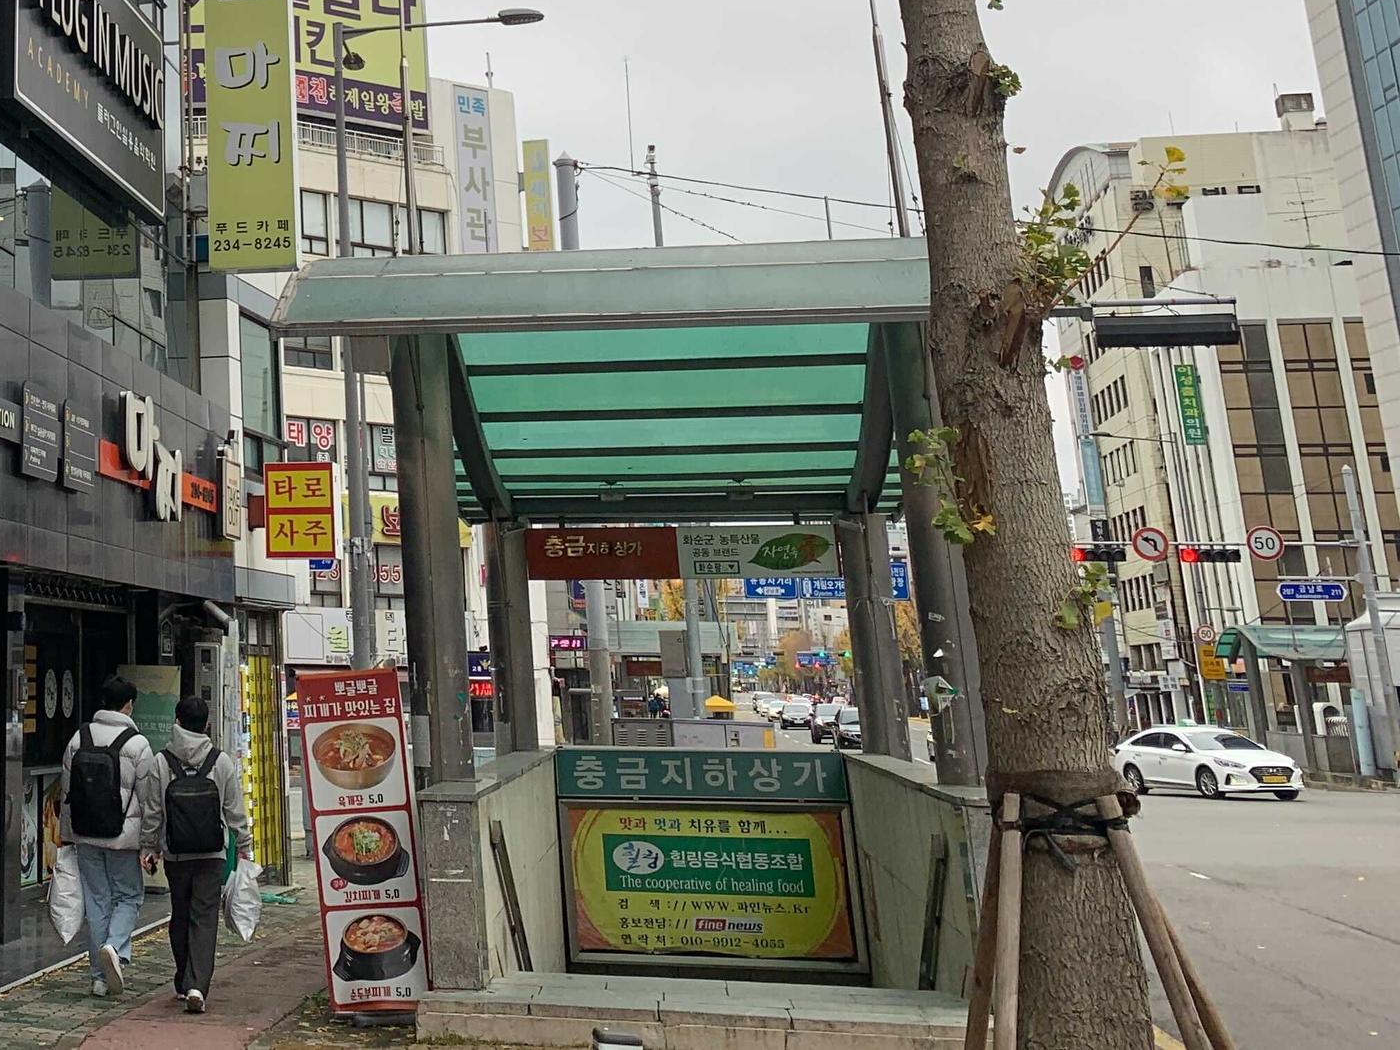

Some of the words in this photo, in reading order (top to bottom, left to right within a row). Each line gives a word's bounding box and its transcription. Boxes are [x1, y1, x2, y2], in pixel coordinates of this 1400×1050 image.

[26, 37, 89, 110] ACADEMY
[93, 0, 110, 77] IN
[114, 23, 164, 130] MUSIC
[457, 94, 486, 117] 민족
[213, 236, 291, 252] 234-8245
[287, 421, 333, 450] 태양
[272, 474, 326, 502] 타로
[273, 519, 327, 547] 사주
[683, 534, 715, 545] 화순군
[719, 534, 760, 545] 농특산물
[1255, 537, 1275, 551] 50
[1199, 630, 1212, 639] 50
[344, 699, 381, 717] 맛있는
[383, 697, 396, 714] 집
[573, 754, 827, 793] 충금지하상가
[618, 816, 647, 831] 맛과
[653, 817, 681, 832] 멋과
[688, 817, 731, 833] 치유를
[669, 849, 805, 871] 힐링음식협동조합
[619, 874, 642, 889] The
[645, 876, 712, 893] cooperative
[715, 878, 729, 891] of
[731, 878, 774, 896] healing
[777, 879, 805, 893] food
[696, 919, 724, 931] fine
[727, 921, 763, 932] news
